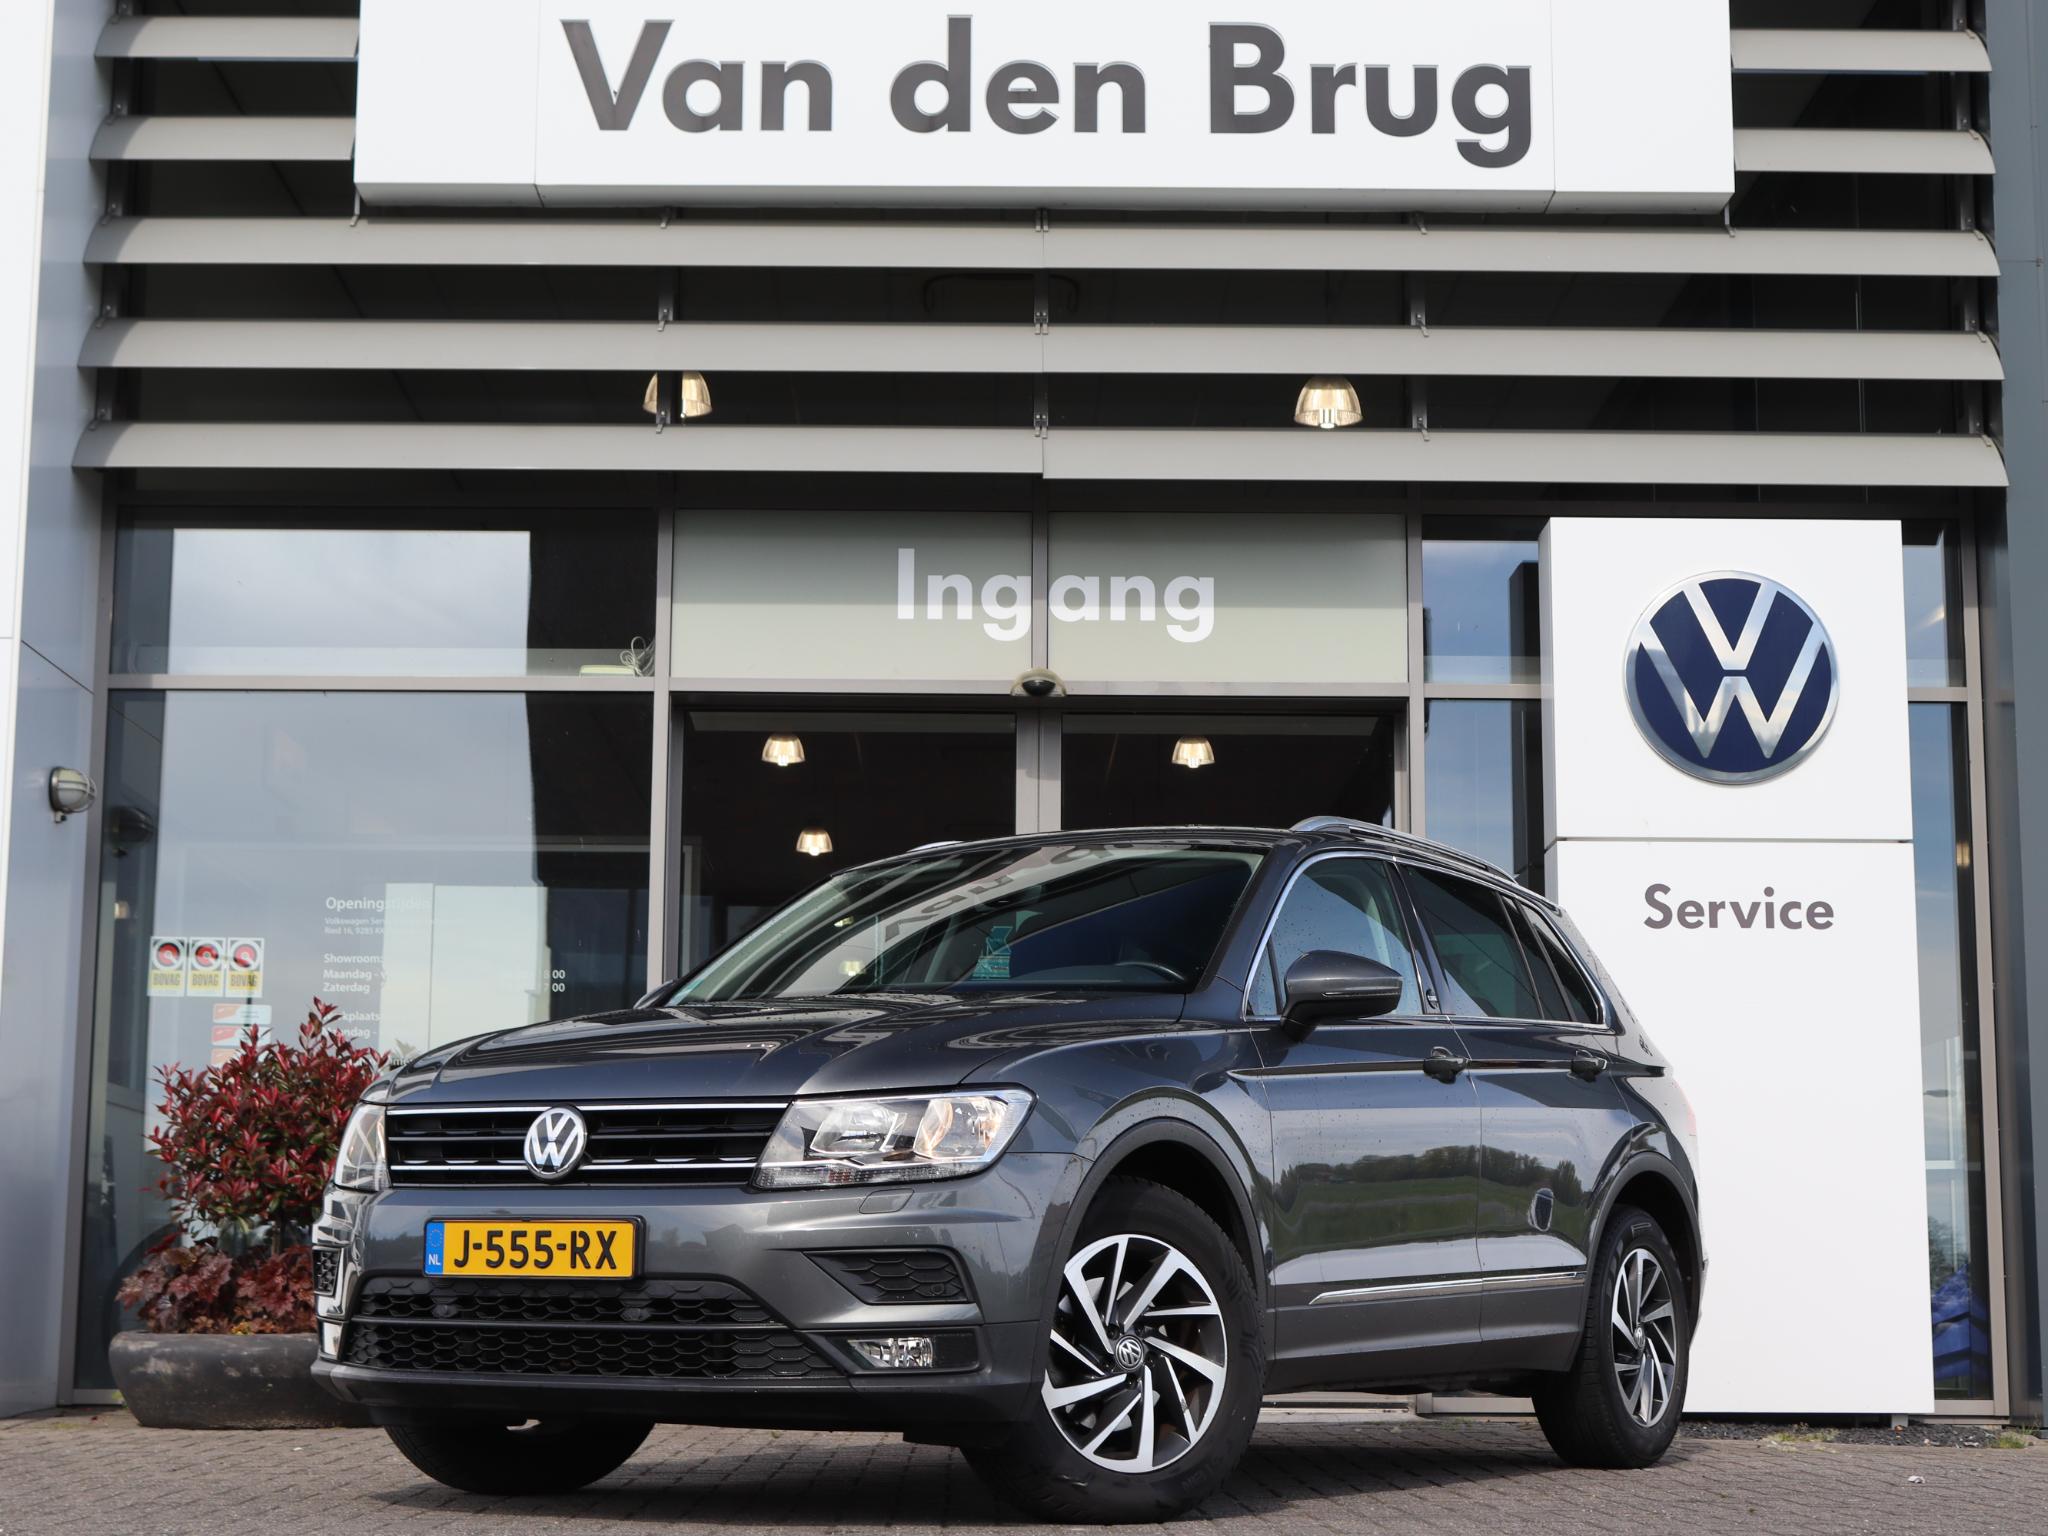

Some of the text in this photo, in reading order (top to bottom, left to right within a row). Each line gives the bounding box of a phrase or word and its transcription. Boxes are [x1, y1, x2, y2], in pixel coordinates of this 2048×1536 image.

[559, 14, 1533, 168] Van den Brug
[897, 547, 1215, 643] Ingang
[1643, 883, 1834, 930] Service
[152, 972, 181, 986] BOVAG
[192, 973, 219, 987] BOVAG
[230, 974, 257, 987] BOVAG
[323, 969, 372, 981] Maandag
[323, 982, 371, 994] Zaterdag
[454, 1229, 618, 1270] J-555-RX
[428, 1254, 441, 1266] NL
